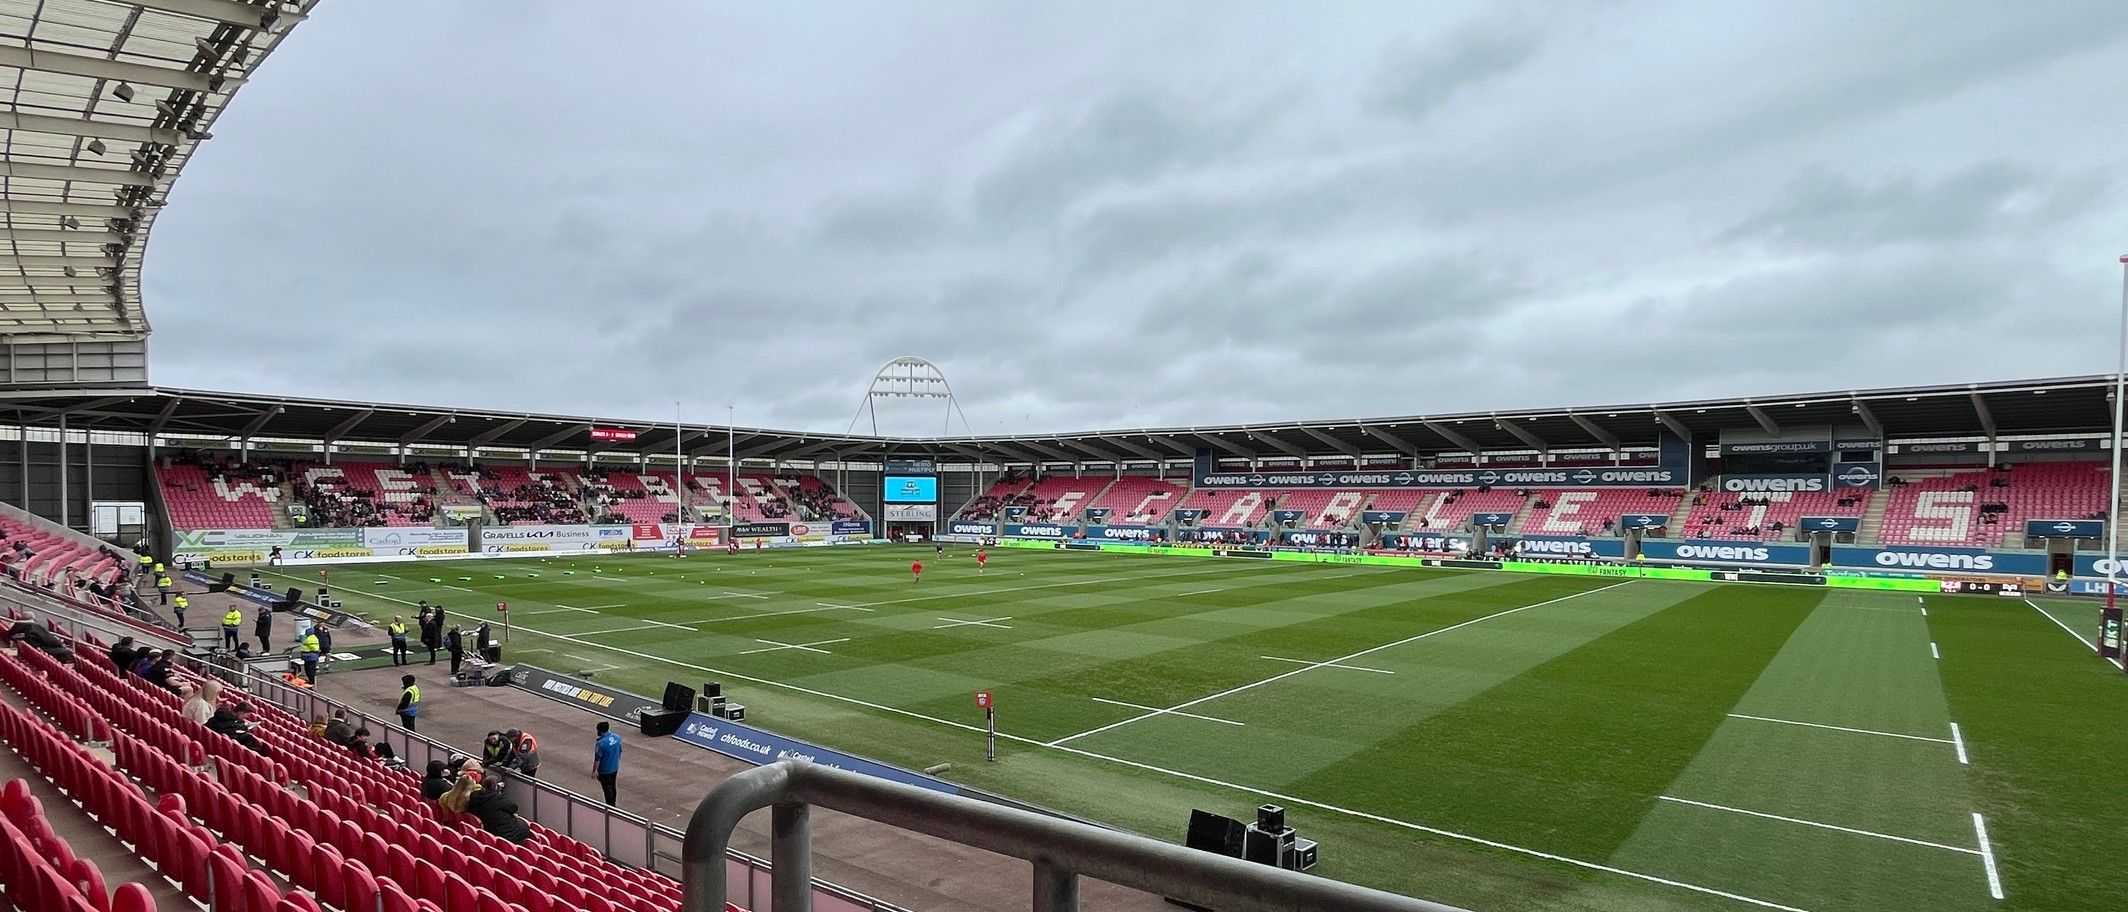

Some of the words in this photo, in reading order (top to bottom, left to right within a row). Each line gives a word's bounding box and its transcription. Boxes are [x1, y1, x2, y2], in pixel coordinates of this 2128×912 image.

[1732, 442, 1817, 453] owensgroup.uk
[1836, 441, 1881, 449] owens
[1910, 443, 1967, 453] owens
[2022, 439, 2086, 450] owens
[1563, 452, 1600, 460] owens
[1203, 476, 1247, 485] owens
[1268, 475, 1315, 484] owens
[1340, 474, 1390, 484] owens
[1417, 473, 1474, 484] owens
[1504, 472, 1566, 483] owens
[1601, 470, 1672, 483] owens
[1838, 473, 1878, 481] owens
[1725, 478, 1822, 492] owens
[953, 524, 993, 534] owens
[1020, 526, 1062, 536] owens
[1104, 528, 1150, 539] owens
[483, 531, 525, 539] GRAVELLS
[556, 530, 589, 538] Business
[398, 547, 418, 556] CK
[419, 547, 467, 555] foodstores
[1516, 540, 1592, 553] owens
[210, 554, 262, 562] odstores
[317, 550, 371, 558] foodstores
[1676, 545, 1769, 561] owens
[1875, 551, 1993, 570] owens
[1600, 568, 1627, 577] FANTASY
[699, 724, 719, 734] Castell
[720, 733, 772, 756] chfoods.co.uk
